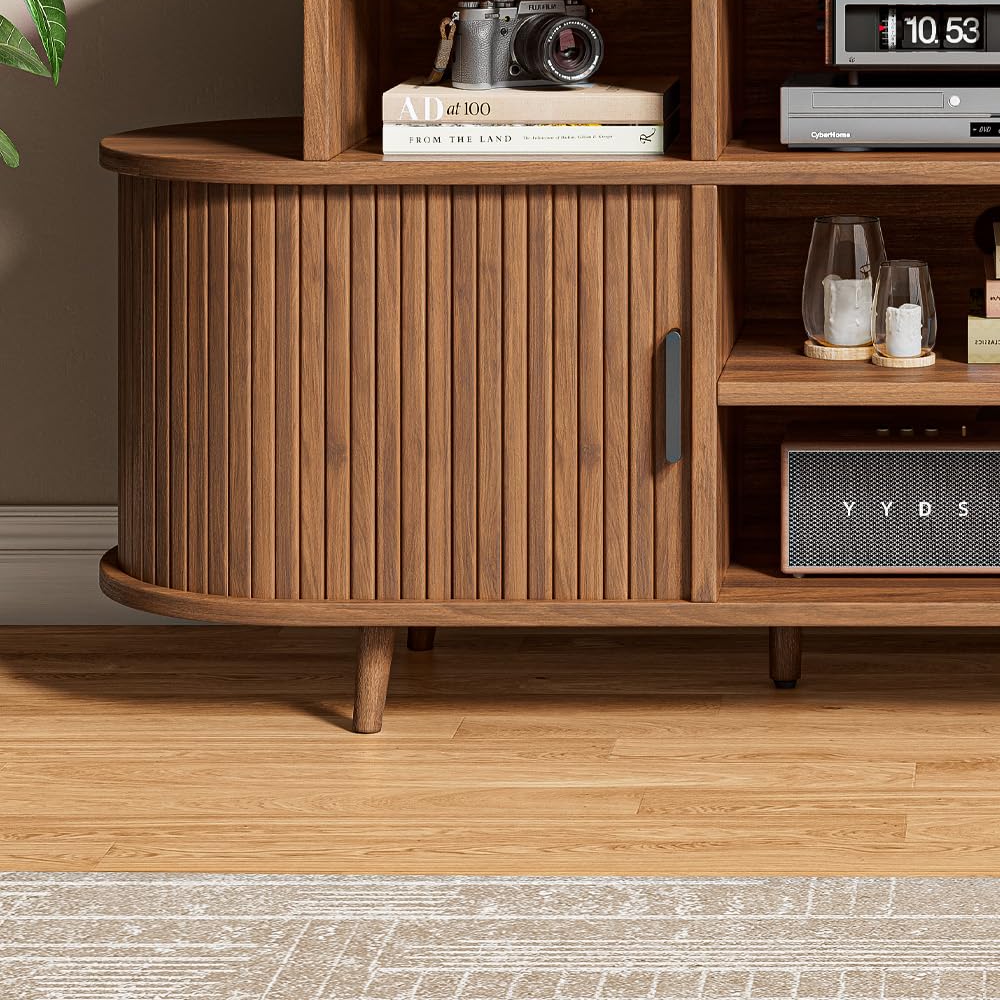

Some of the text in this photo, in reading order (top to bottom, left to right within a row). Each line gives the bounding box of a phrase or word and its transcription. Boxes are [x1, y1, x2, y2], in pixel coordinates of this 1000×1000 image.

[945, 16, 980, 44] 53
[399, 96, 491, 121] AD at 100
[408, 135, 512, 144] FROM THE LAND
[811, 131, 851, 140] CyberHome
